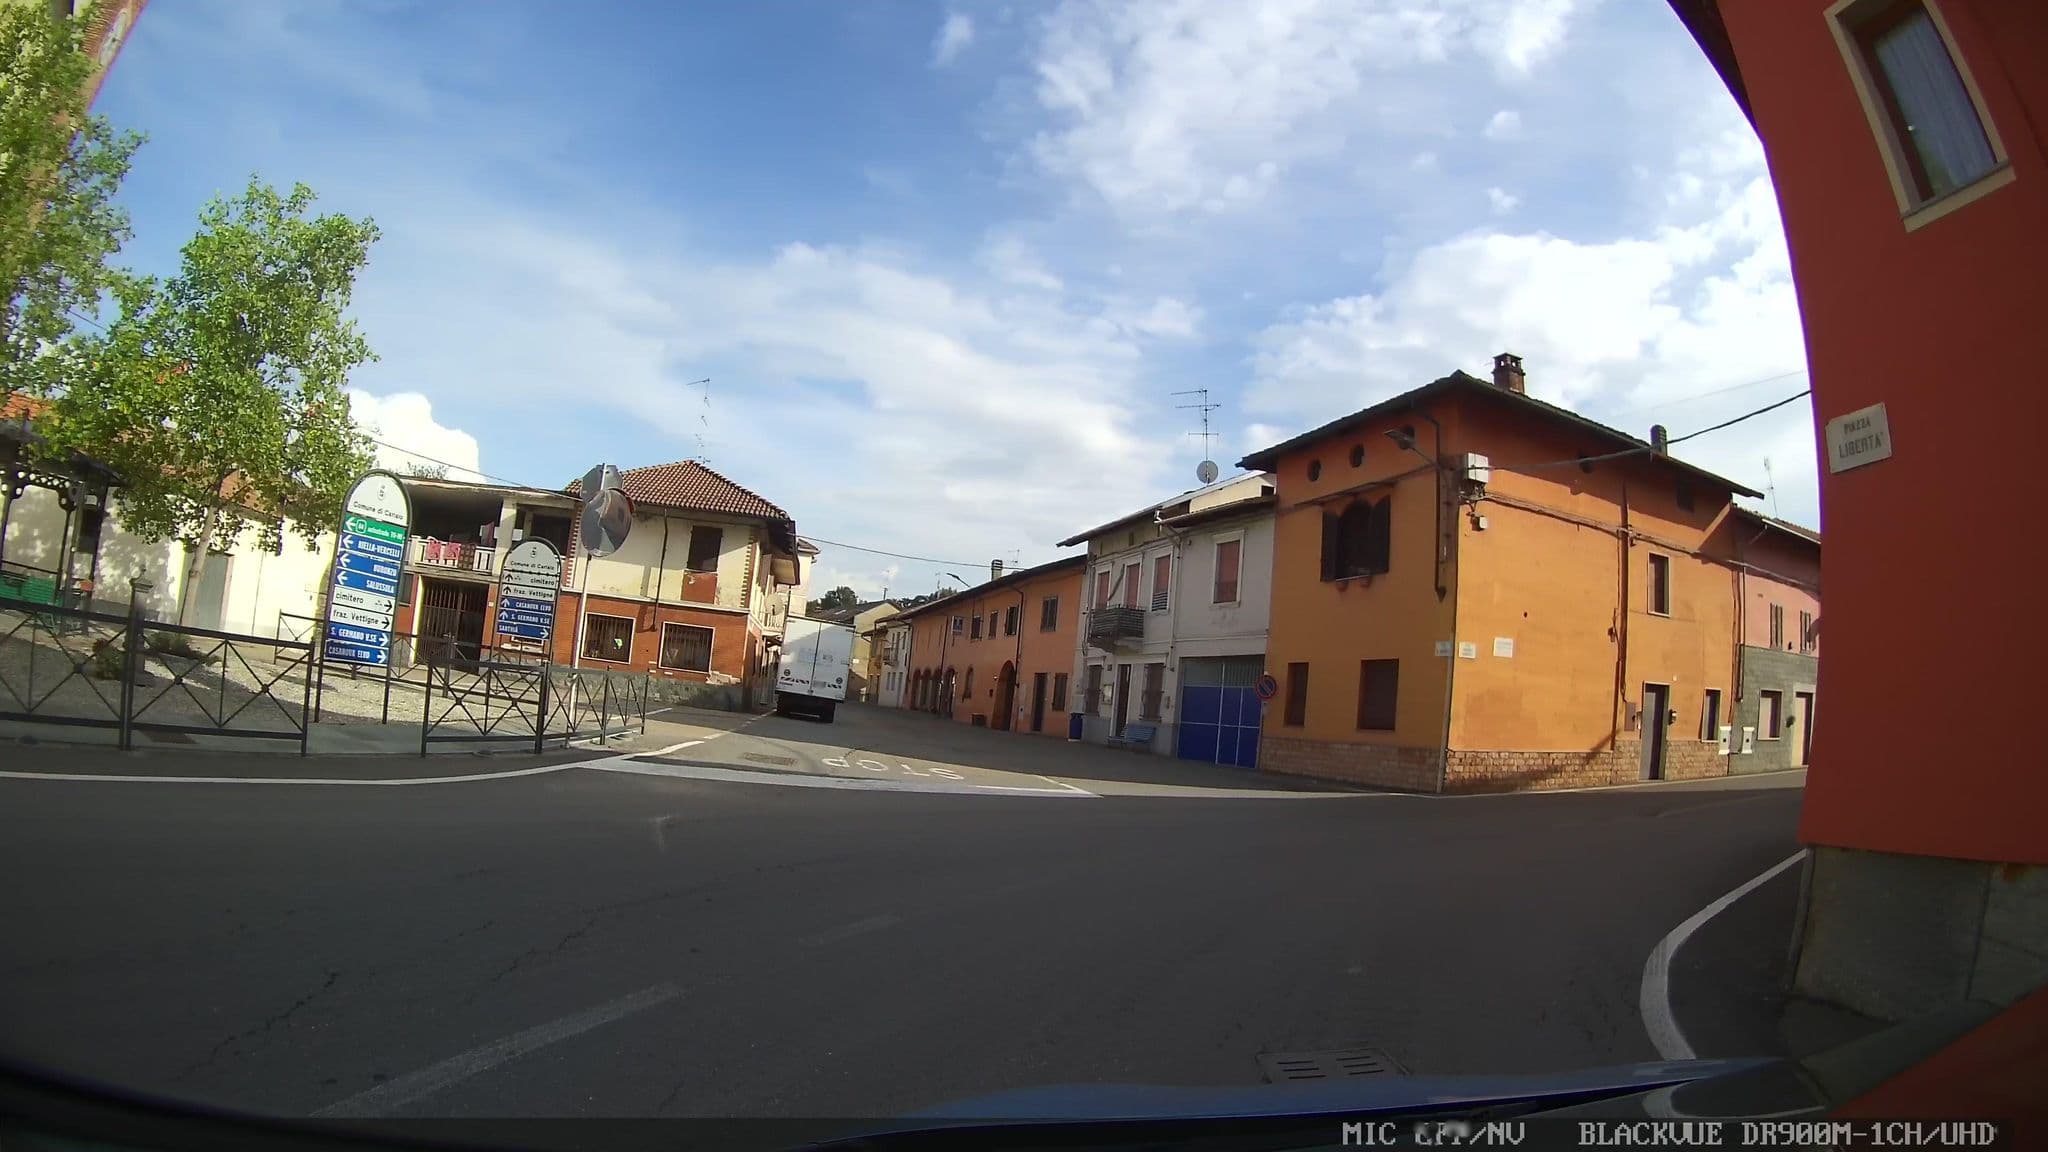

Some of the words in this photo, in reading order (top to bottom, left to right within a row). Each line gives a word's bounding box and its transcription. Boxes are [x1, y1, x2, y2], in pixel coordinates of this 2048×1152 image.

[1844, 416, 1871, 435] PIAZZA
[336, 592, 364, 604] cimitero
[351, 612, 379, 624] Vettigne
[328, 646, 356, 657] CASANOVA
[822, 757, 965, 780] STOP
